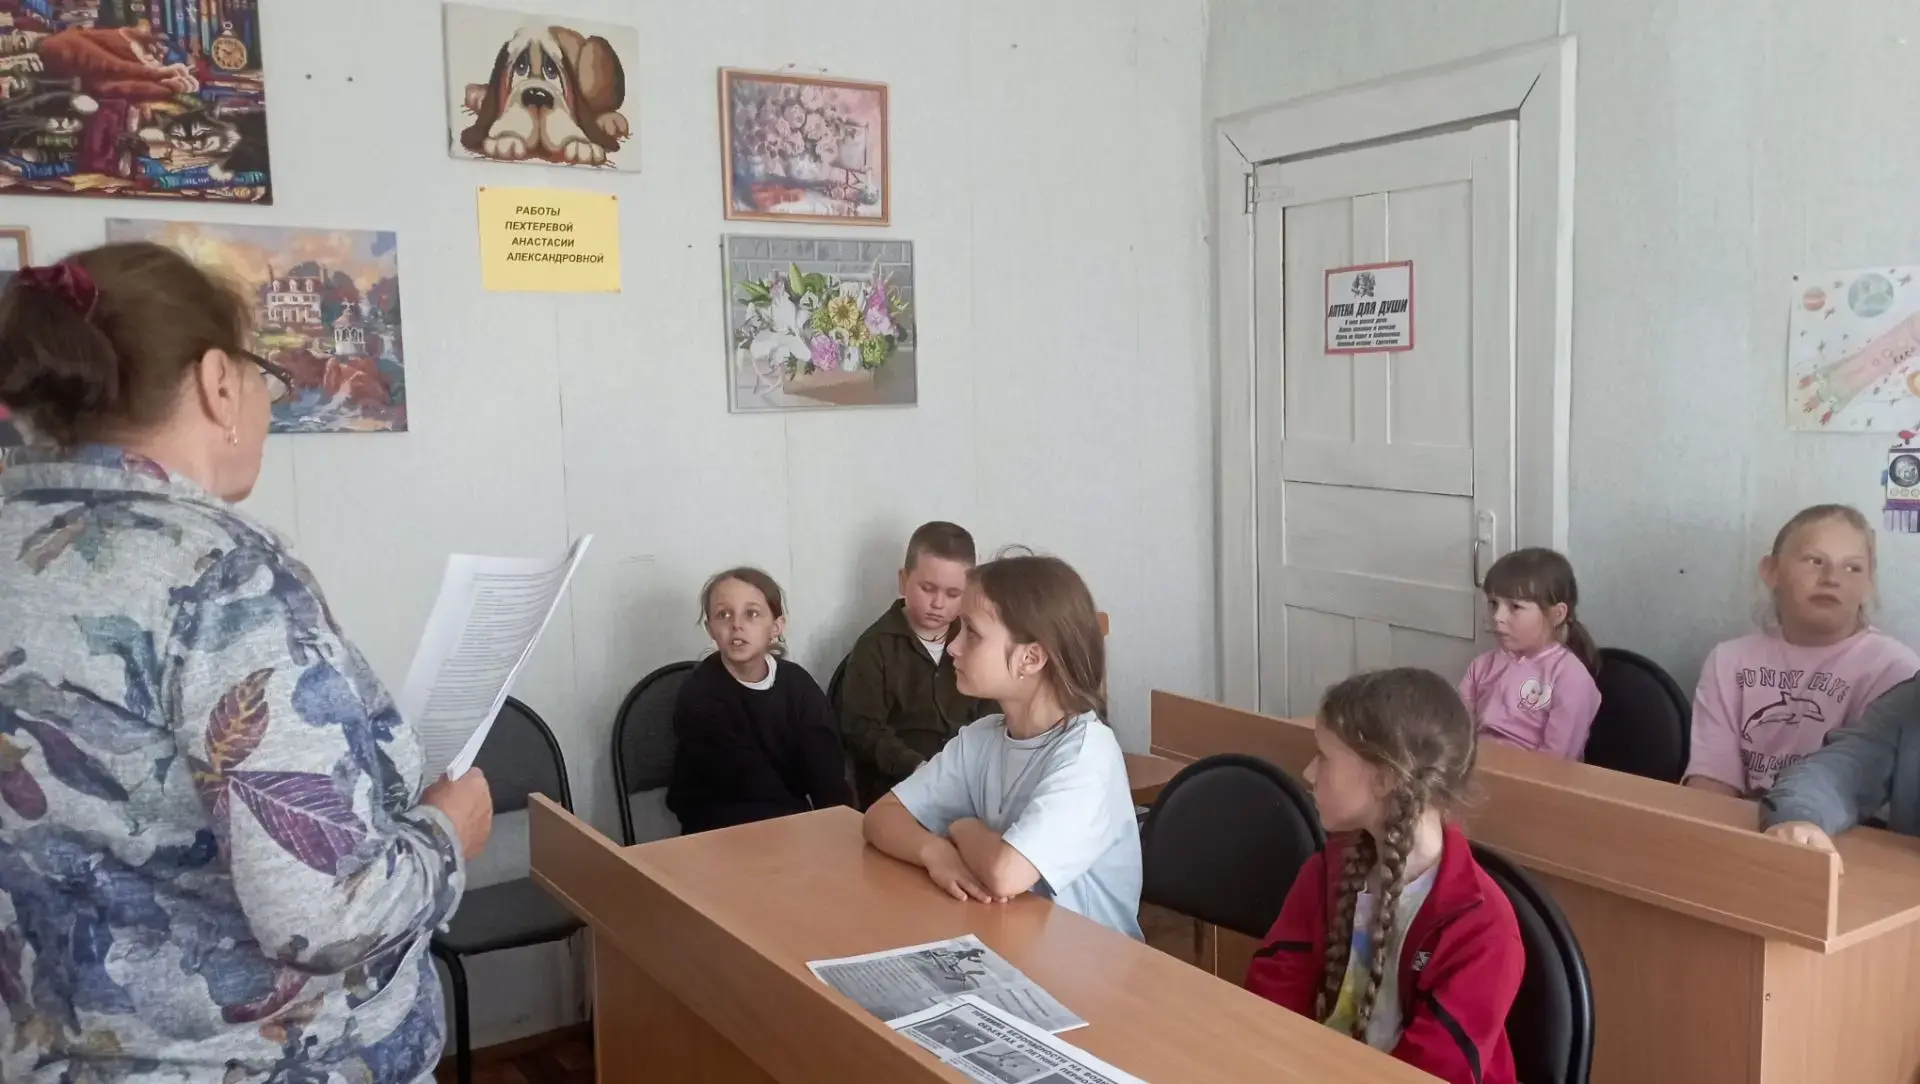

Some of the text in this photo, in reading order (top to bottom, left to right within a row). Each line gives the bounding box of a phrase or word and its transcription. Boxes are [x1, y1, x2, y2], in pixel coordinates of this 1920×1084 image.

[515, 206, 561, 216] РАБОТЫ
[505, 221, 574, 232] ПЕХТЕРЕВОЙ
[511, 237, 575, 247] АНАСТАСИИ
[506, 252, 604, 264] АЛЕКСАНДРОВНОЙ
[1327, 299, 1408, 317] АПТЕКА ДЛЯ ДУШИ
[971, 1010, 1005, 1030] ПРАВИЛА
[1006, 1029, 1068, 1064] БЕЗОПАСНОСТИ
[1068, 1064, 1082, 1072] НА
[977, 1022, 1017, 1045] ОБЪЕКТАХ
[1025, 1048, 1060, 1068] ЛЕТНИЙ
[1059, 1067, 1094, 1084] ПЕРИО
